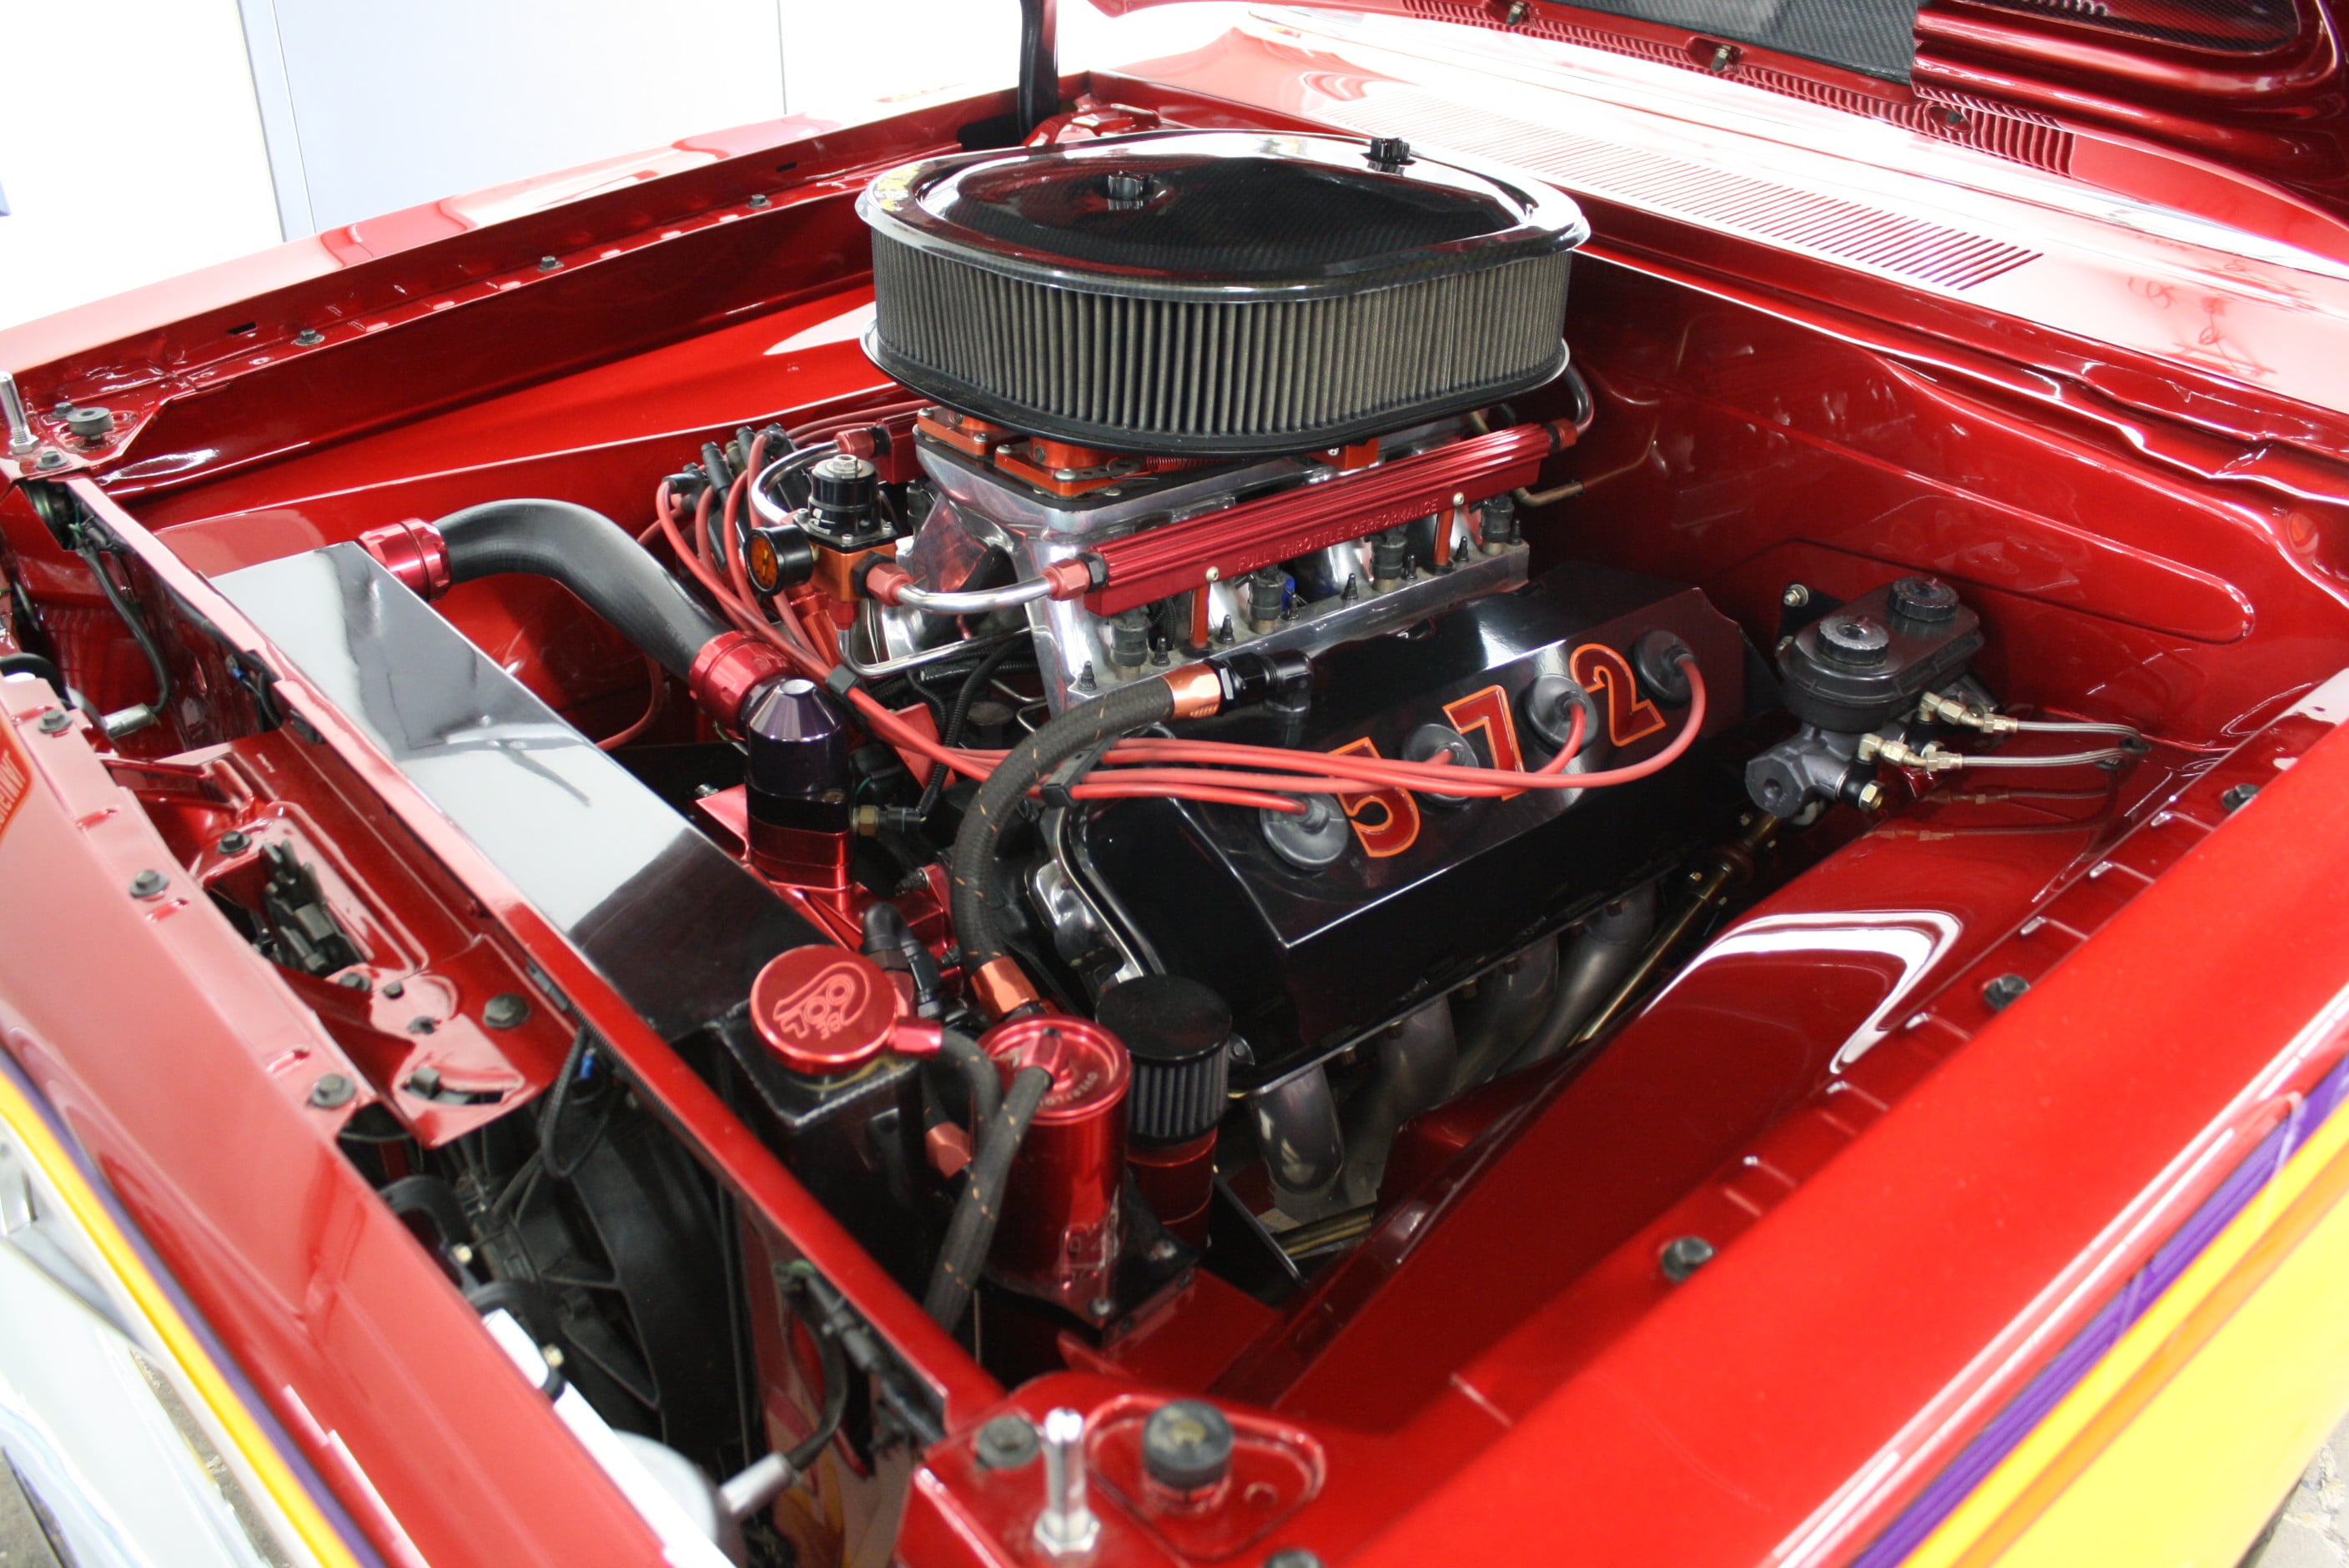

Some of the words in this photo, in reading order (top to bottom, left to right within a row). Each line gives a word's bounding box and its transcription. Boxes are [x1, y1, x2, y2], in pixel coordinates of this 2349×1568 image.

[1237, 547, 1270, 572] FULL
[1279, 525, 1345, 560] THROTTLE
[1351, 499, 1439, 537] PERFORMANCE
